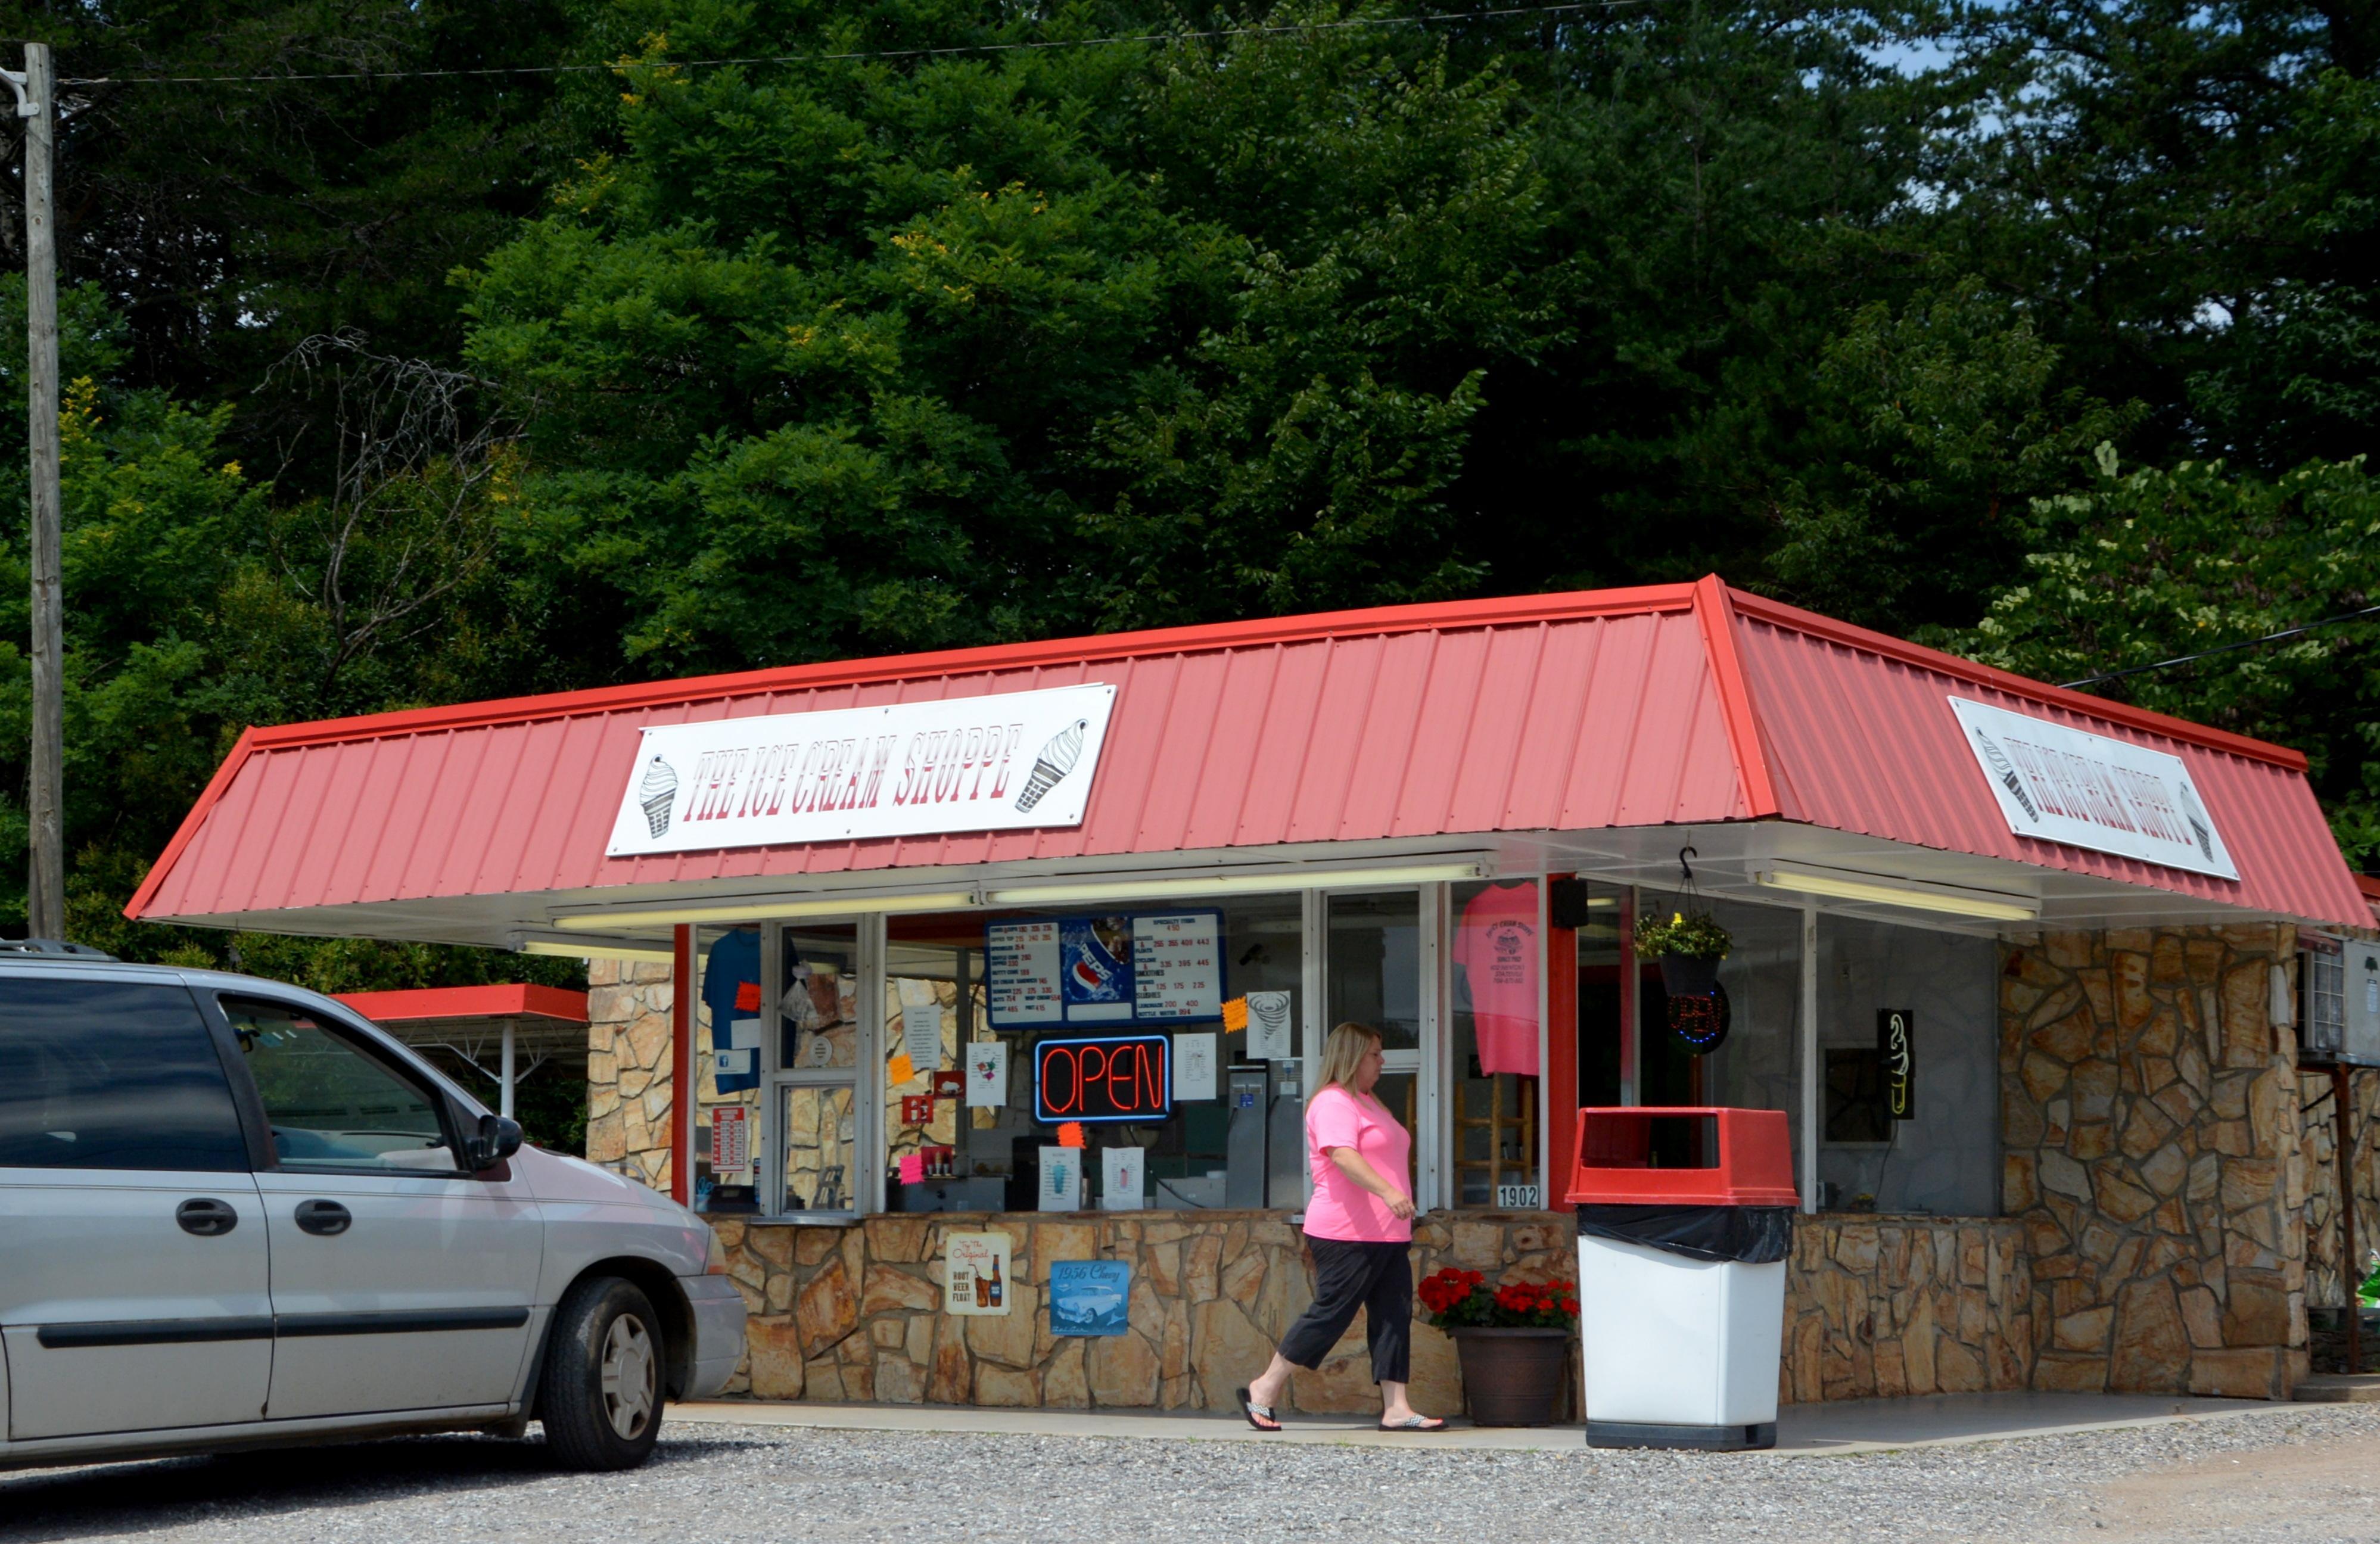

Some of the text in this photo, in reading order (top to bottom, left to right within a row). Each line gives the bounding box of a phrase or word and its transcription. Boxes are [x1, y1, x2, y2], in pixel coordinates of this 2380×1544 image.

[683, 723, 1023, 822] THE ICE CREAM SHOPPE
[1079, 943, 1113, 981] PEPS
[1043, 1044, 1163, 1113] OPEN
[1501, 1187, 1537, 1206] 1902
[953, 1249, 989, 1263] Original
[953, 1271, 969, 1280] ROOT
[1058, 1263, 1120, 1282] 1956 Chevy
[953, 1282, 969, 1291] BEER
[953, 1293, 970, 1302] FLOAT
